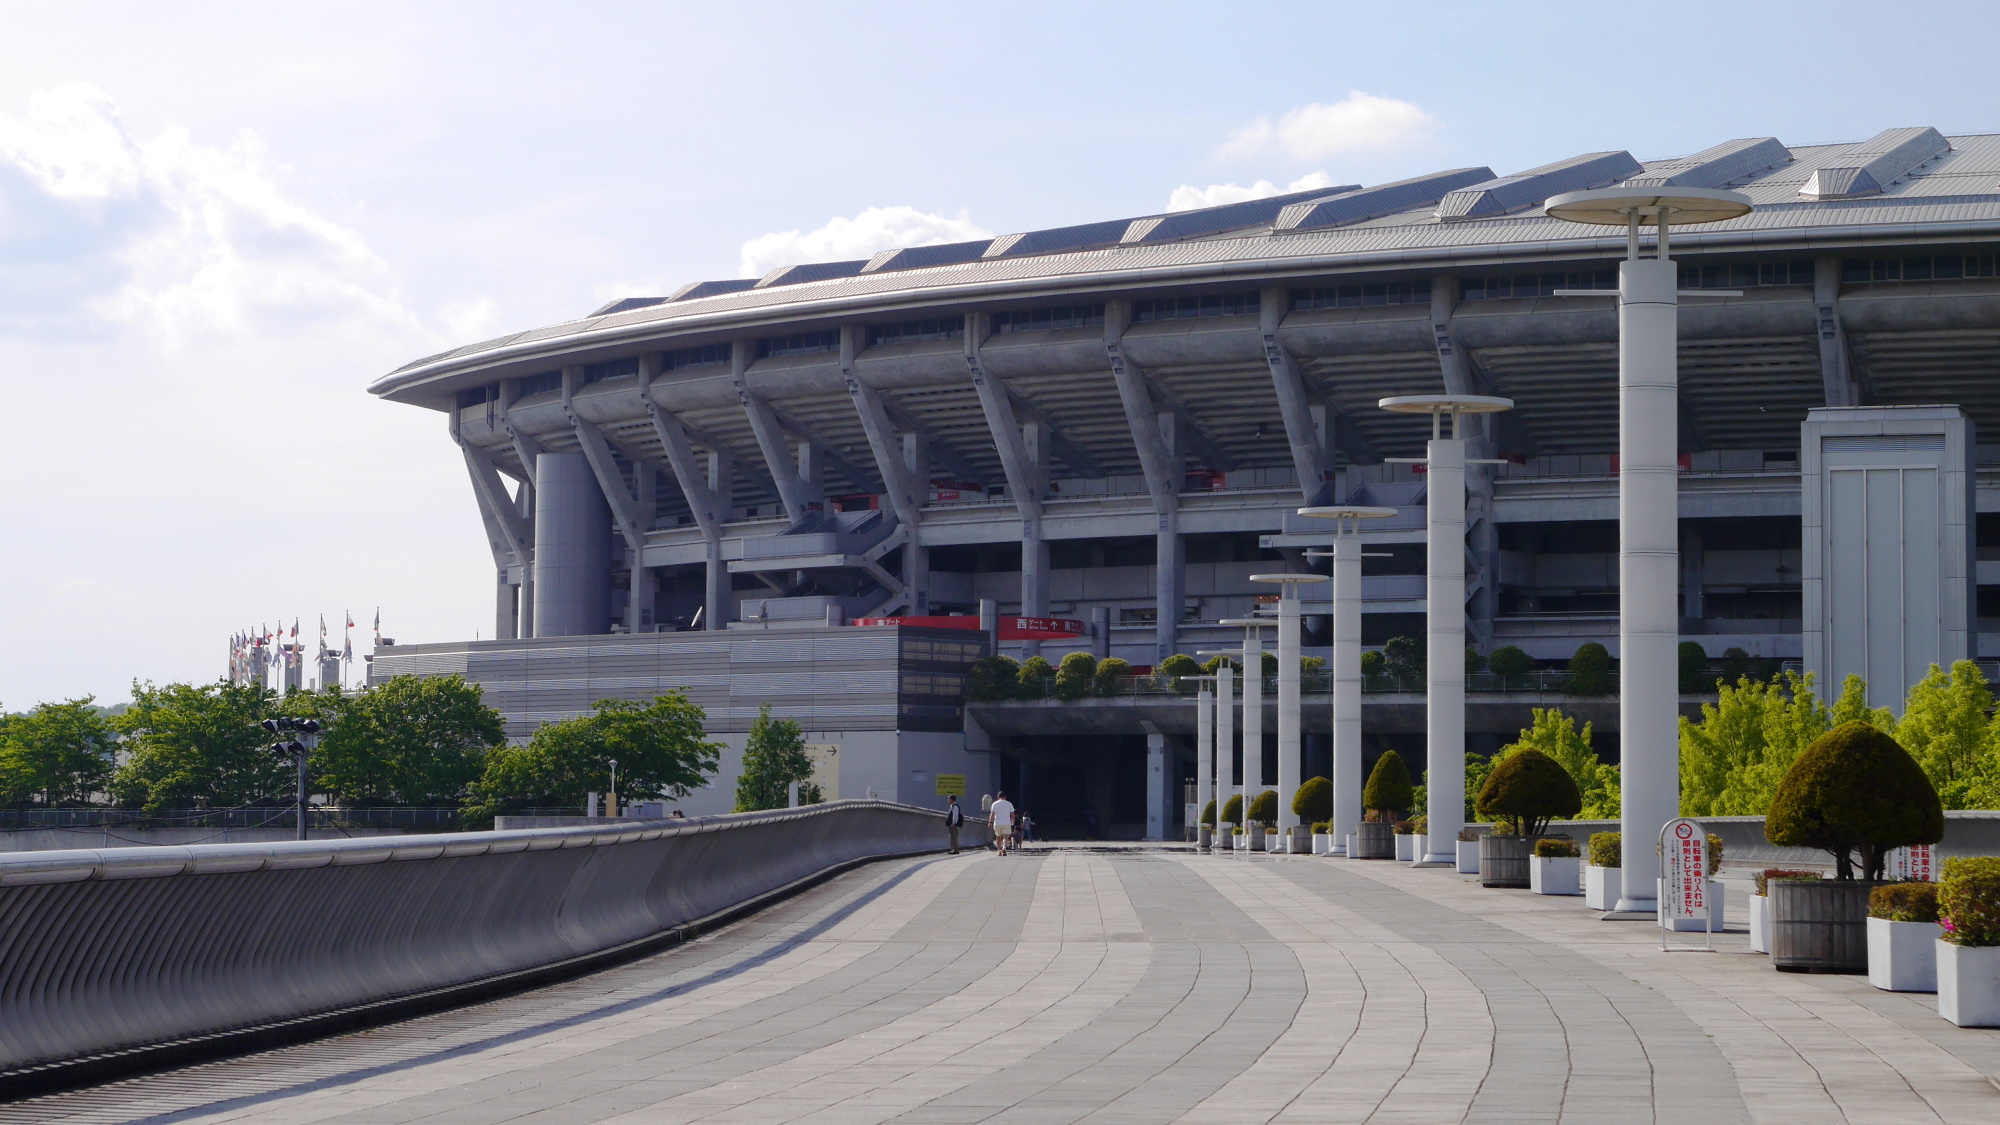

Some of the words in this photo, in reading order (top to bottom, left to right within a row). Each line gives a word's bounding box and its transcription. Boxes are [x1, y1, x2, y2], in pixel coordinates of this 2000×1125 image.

[1682, 840, 1693, 917] 原則として出来ません。
[1693, 840, 1703, 908] 自転車の乗り入れは
